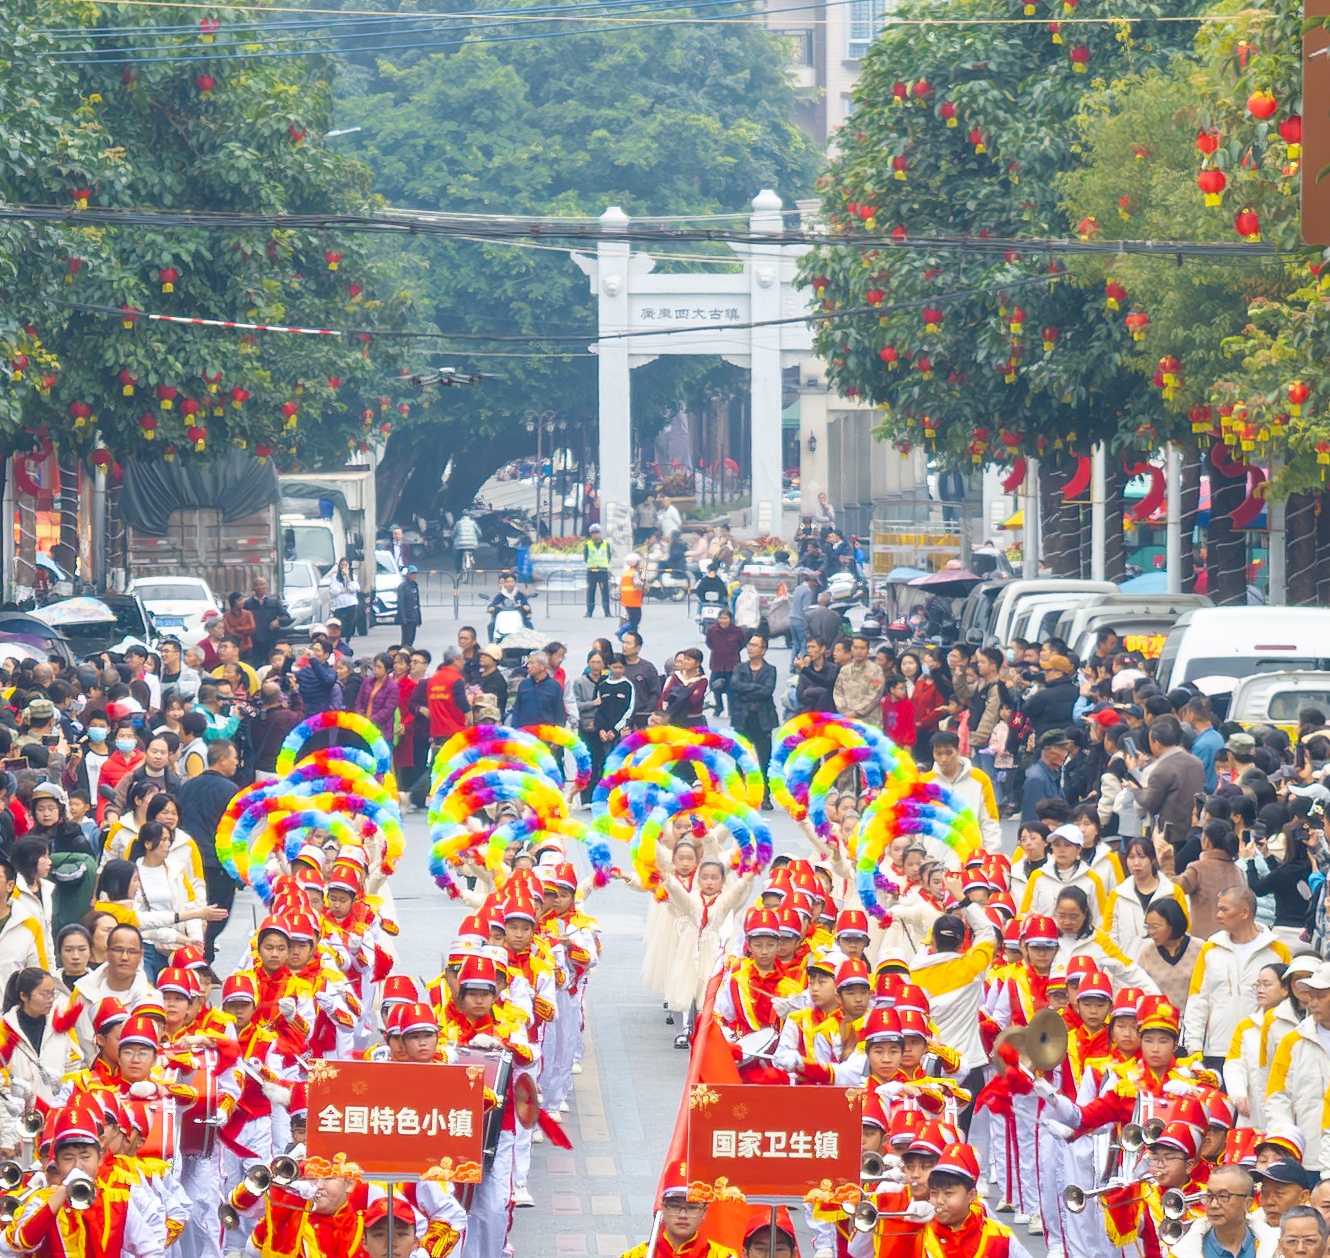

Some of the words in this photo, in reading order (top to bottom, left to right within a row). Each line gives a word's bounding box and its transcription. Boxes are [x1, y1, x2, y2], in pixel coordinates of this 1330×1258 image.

[318, 1104, 473, 1137] 全国特色小镇
[712, 1129, 839, 1160] 国家卫生镇
